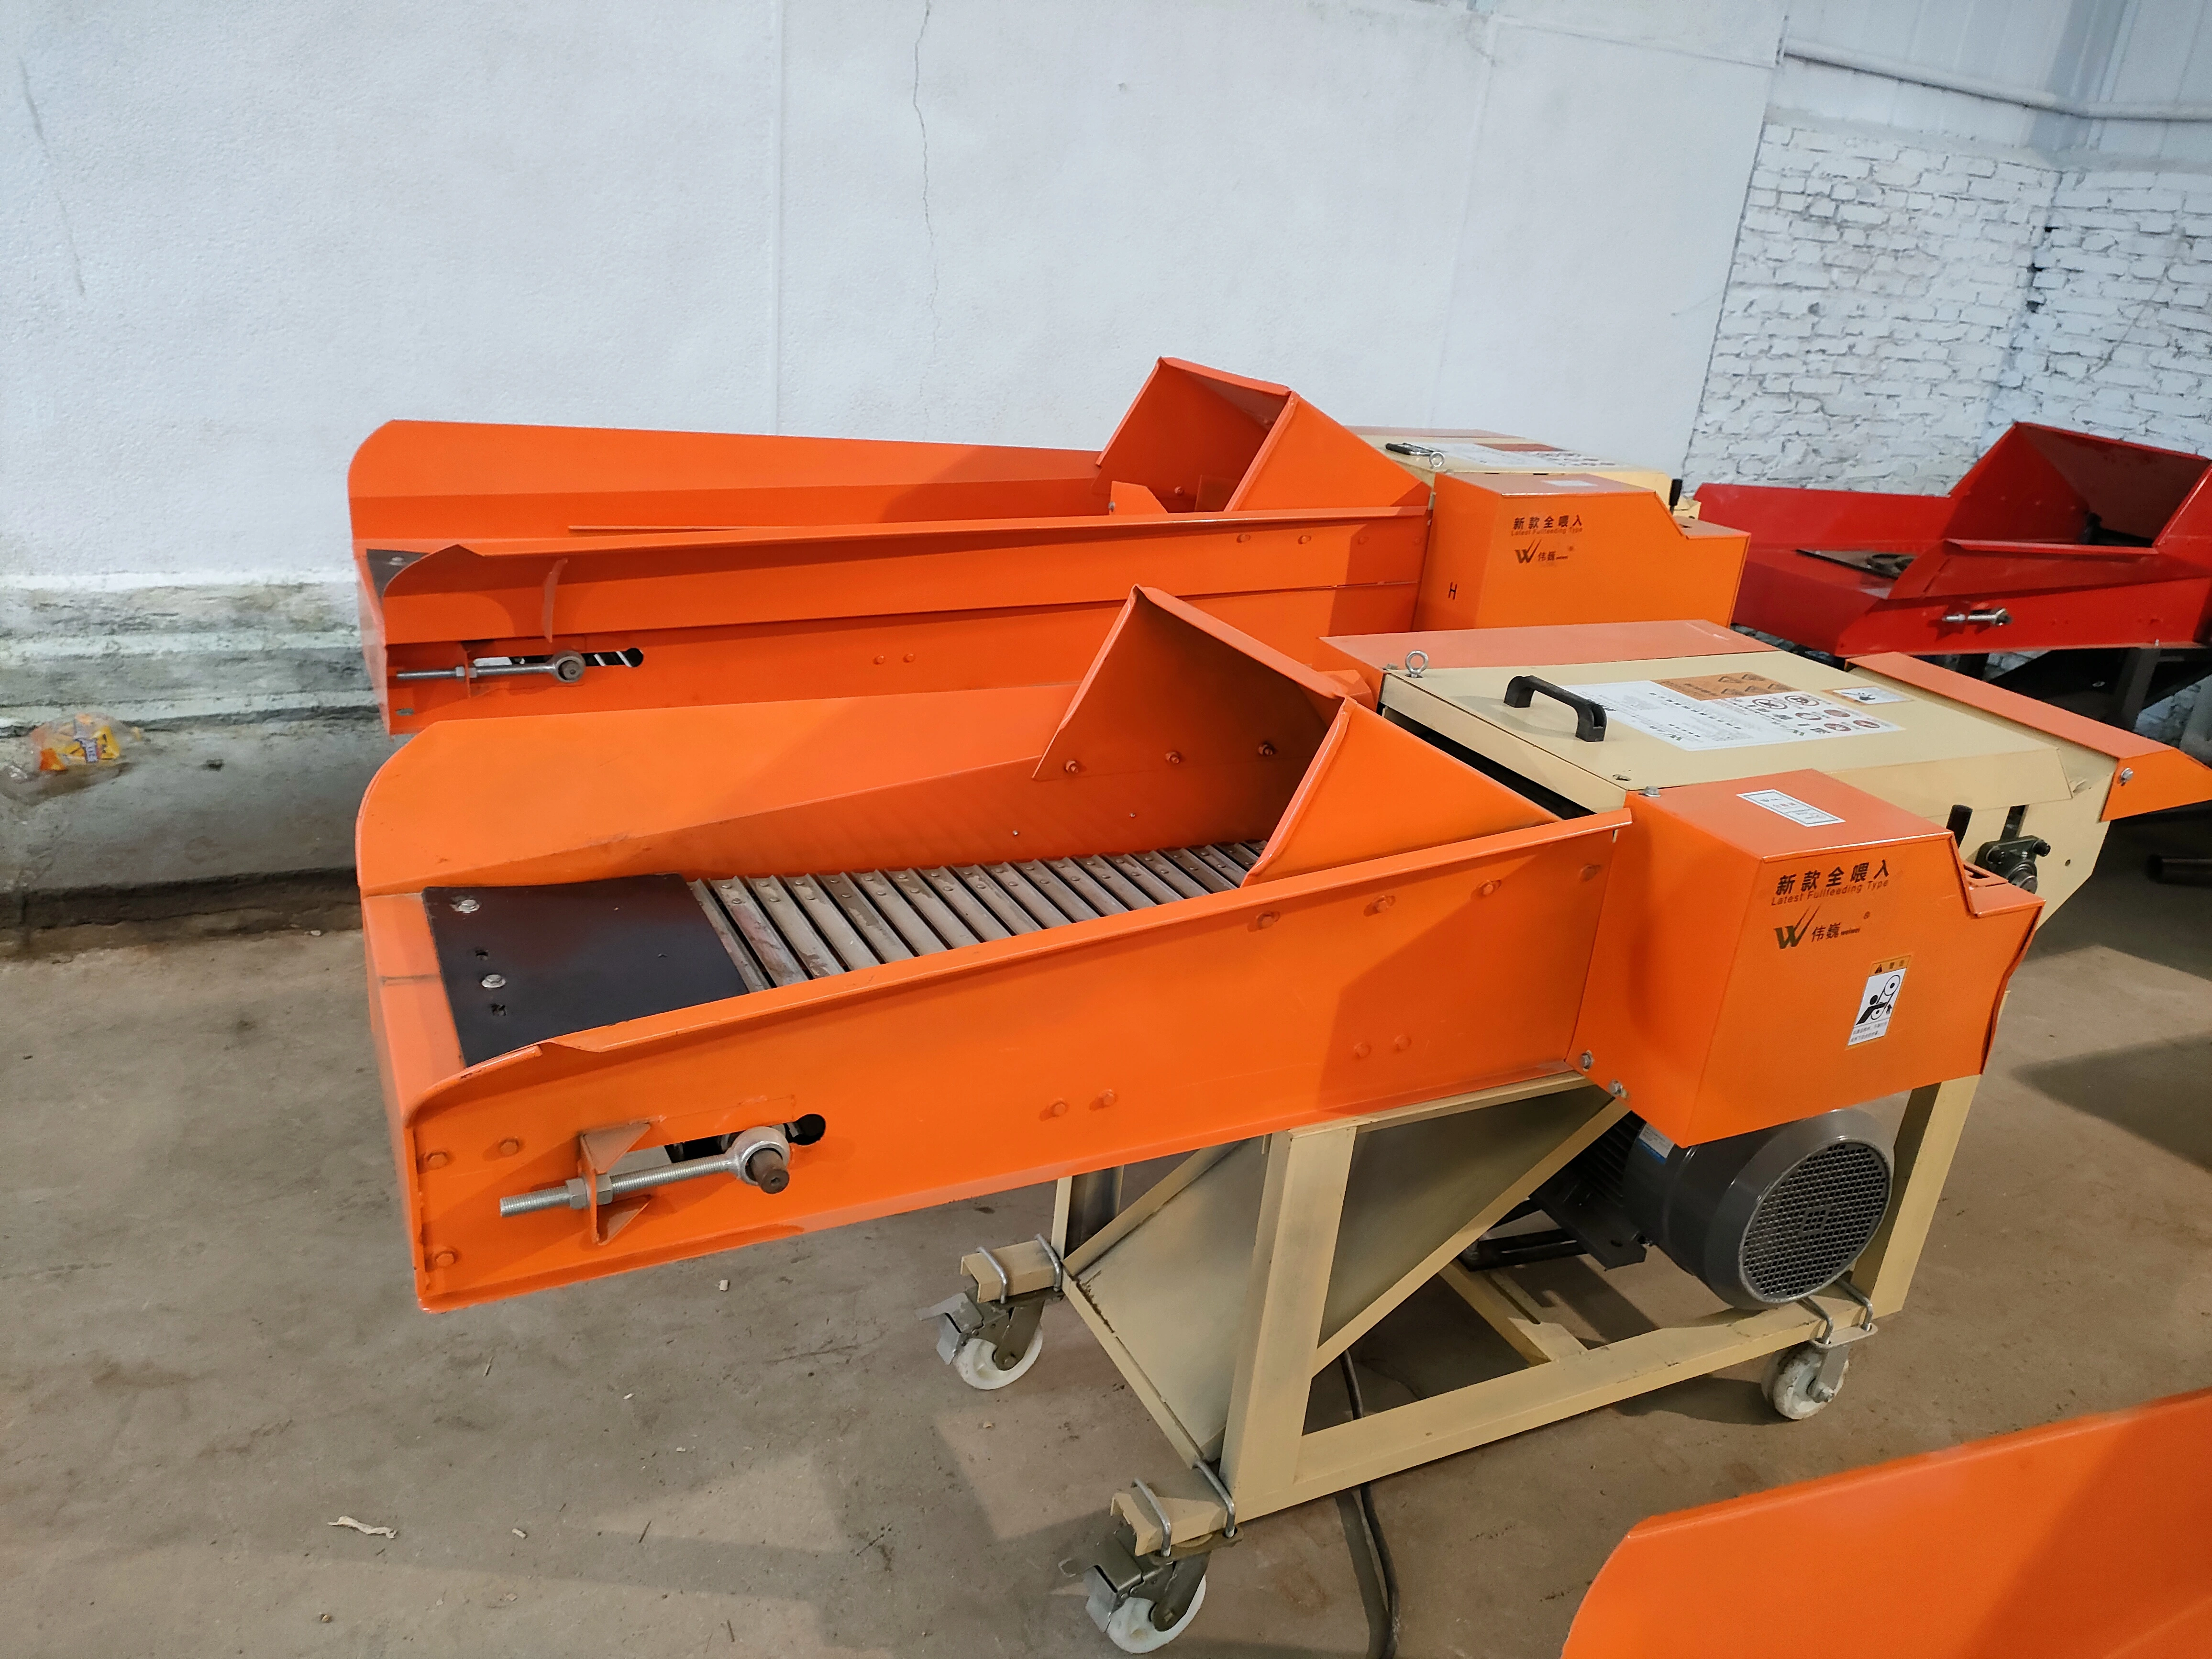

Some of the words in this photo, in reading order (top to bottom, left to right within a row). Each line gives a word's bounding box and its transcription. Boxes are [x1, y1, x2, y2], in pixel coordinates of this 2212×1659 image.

[1513, 514, 1582, 530] 新款全喂入
[1775, 859, 1889, 896] 新款全喂入
[1771, 893, 1803, 906] Latest
[1807, 884, 1862, 900] Fullfeeding
[1867, 880, 1888, 892] Type
